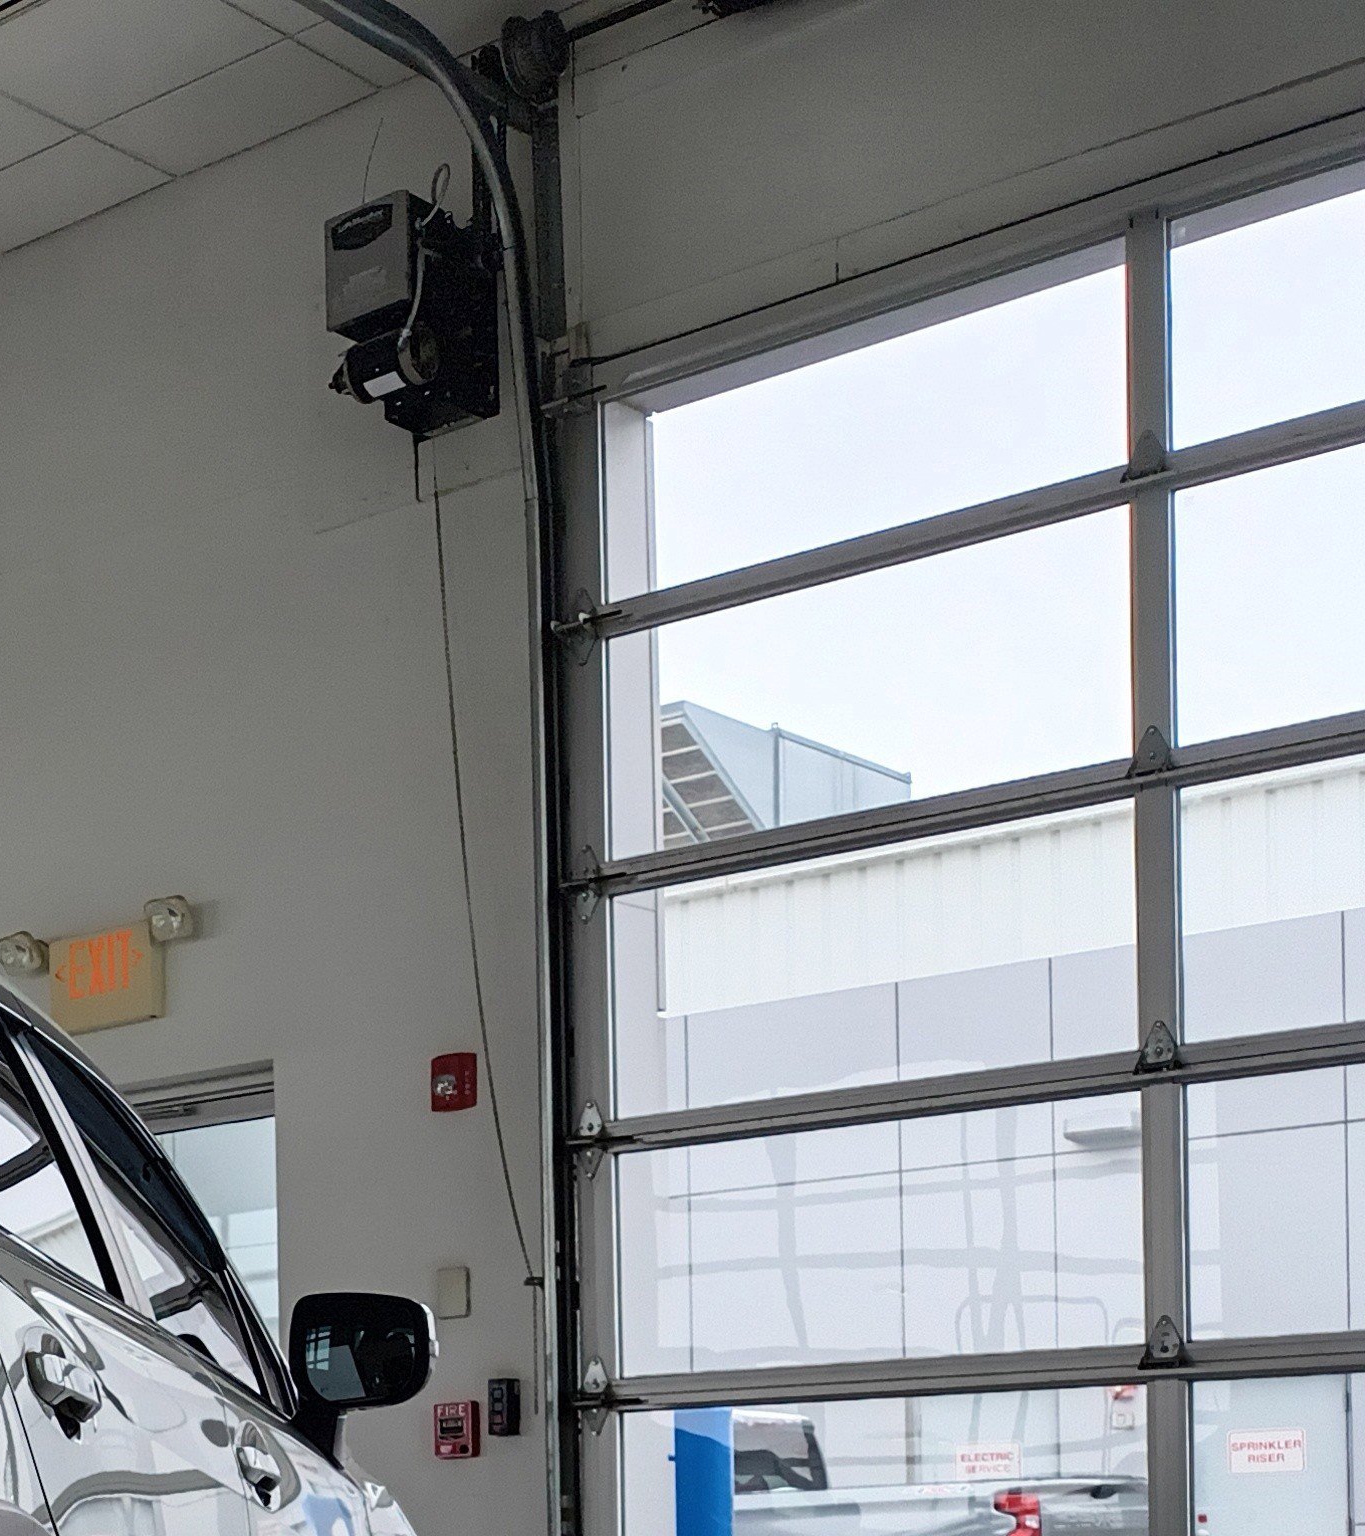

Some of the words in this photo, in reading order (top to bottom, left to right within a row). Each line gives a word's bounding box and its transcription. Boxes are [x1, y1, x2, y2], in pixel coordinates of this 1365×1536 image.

[69, 929, 132, 998] EXIT
[437, 1404, 466, 1417] FIRE
[1231, 1440, 1302, 1452] SPRINKLER
[960, 1452, 1015, 1463] ELECTRIC
[1247, 1453, 1285, 1463] RISER
[965, 1464, 1012, 1475] SERVICE
